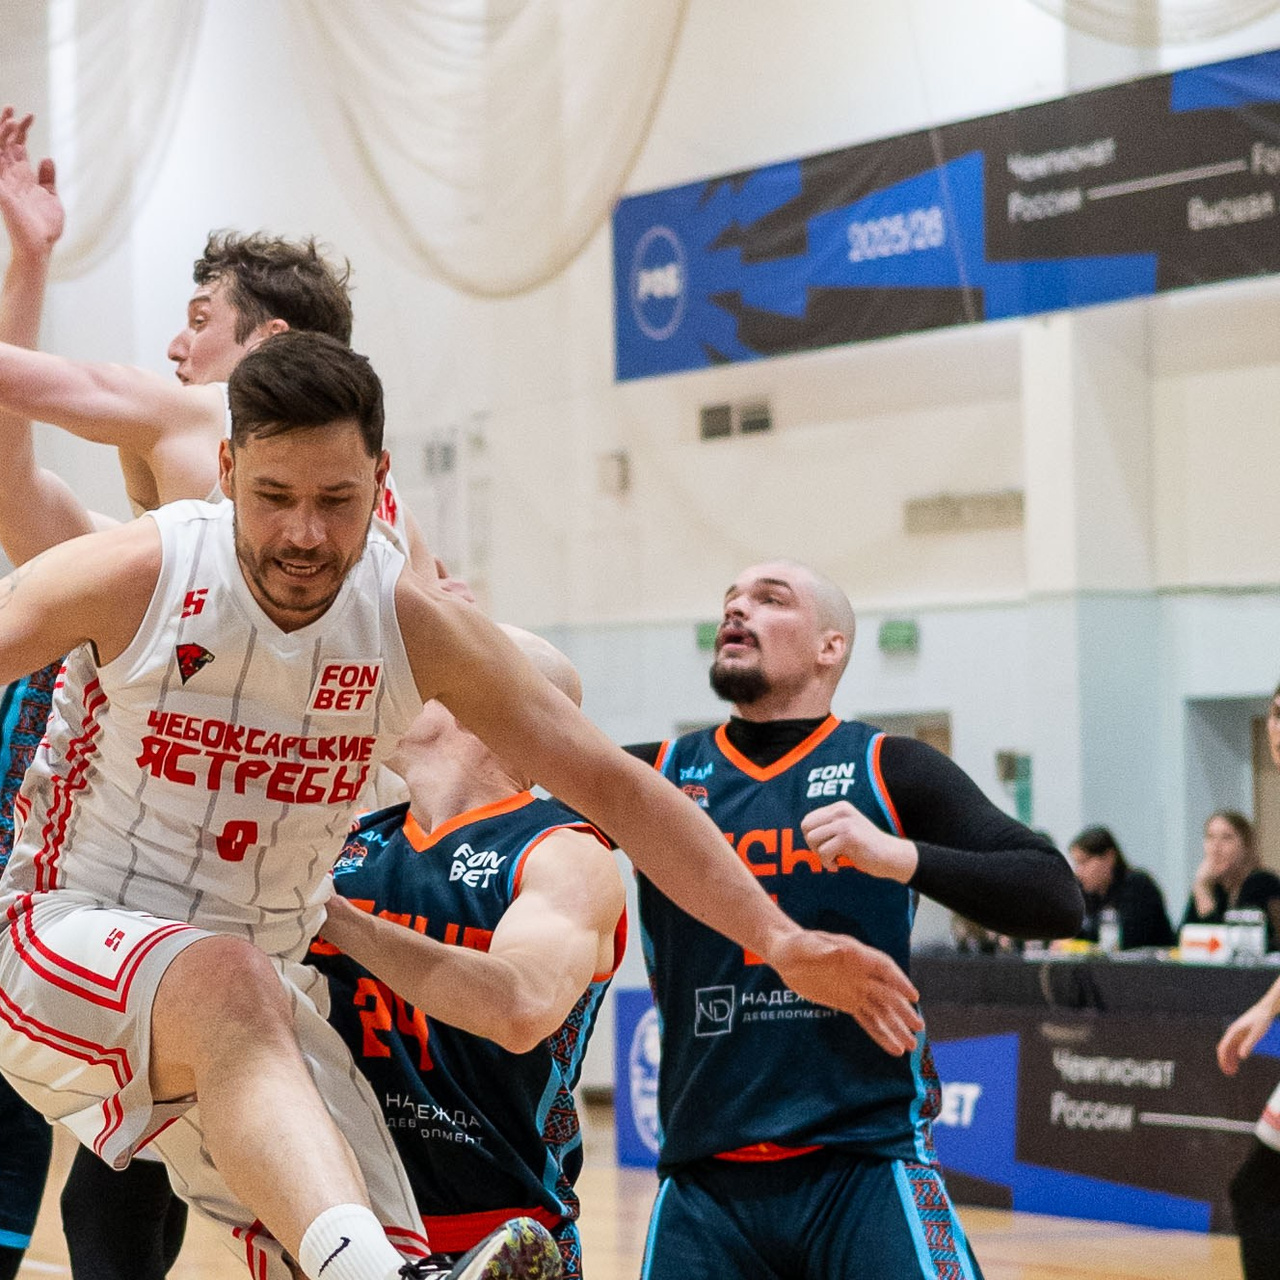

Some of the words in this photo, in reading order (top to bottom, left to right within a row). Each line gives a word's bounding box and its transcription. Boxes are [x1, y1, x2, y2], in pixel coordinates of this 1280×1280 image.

[320, 665, 380, 688] FON
[313, 688, 373, 711] BET
[147, 709, 377, 762] ЧЕБОКСАРСКИЕ
[136, 735, 371, 805] ЯСТРЕБЫ
[807, 762, 856, 783] FON
[806, 778, 856, 799] BET
[453, 842, 507, 869] FON
[448, 860, 500, 889] BET
[353, 976, 435, 1072] 24
[1050, 1090, 1135, 1133] России
